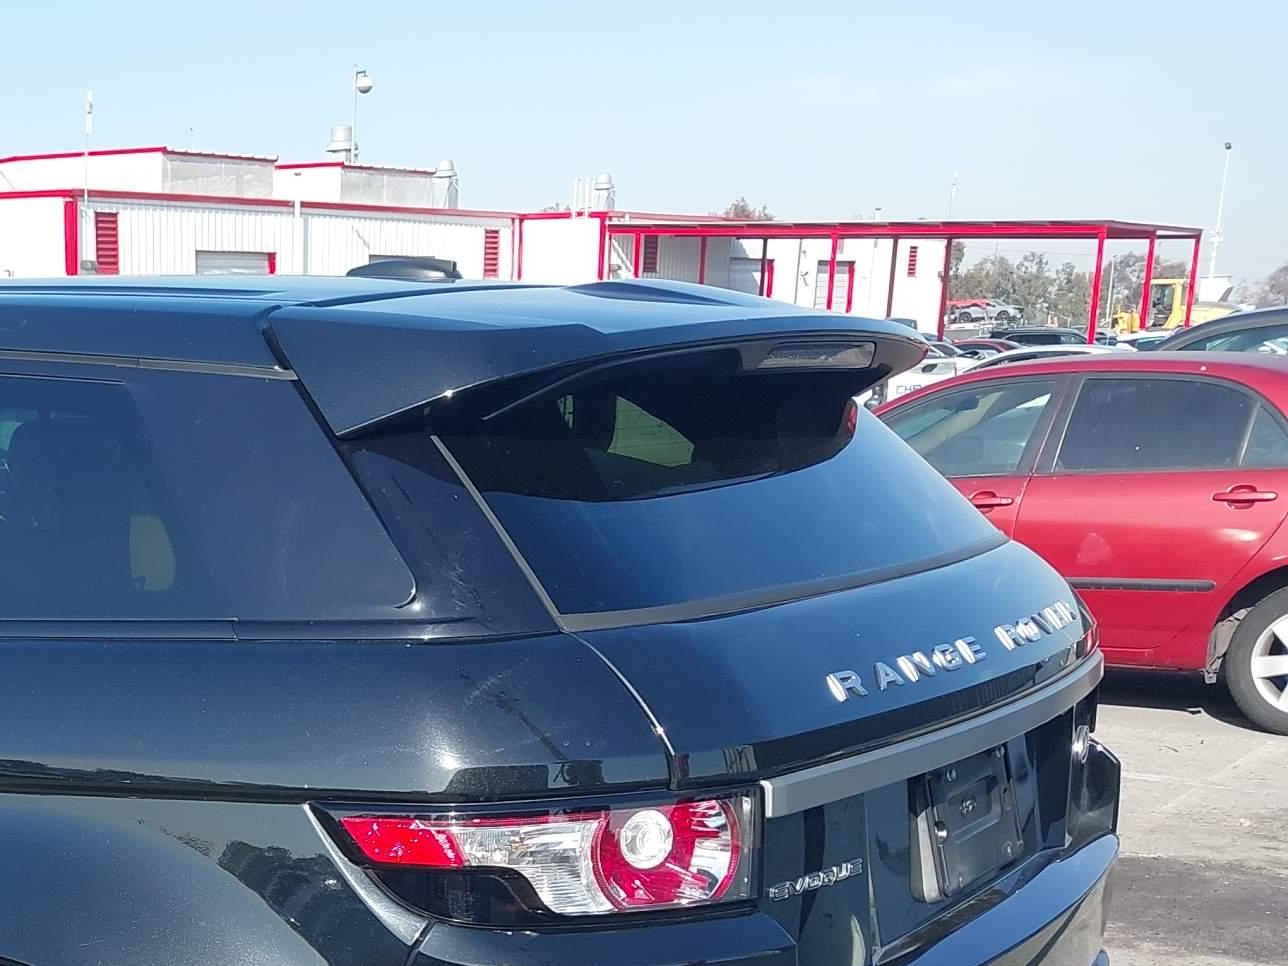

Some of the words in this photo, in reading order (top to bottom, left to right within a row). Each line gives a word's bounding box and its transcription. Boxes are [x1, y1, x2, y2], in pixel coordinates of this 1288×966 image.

[826, 637, 987, 702] RANGE
[994, 601, 1077, 651] ROVER
[768, 857, 863, 902] EVOQUE
